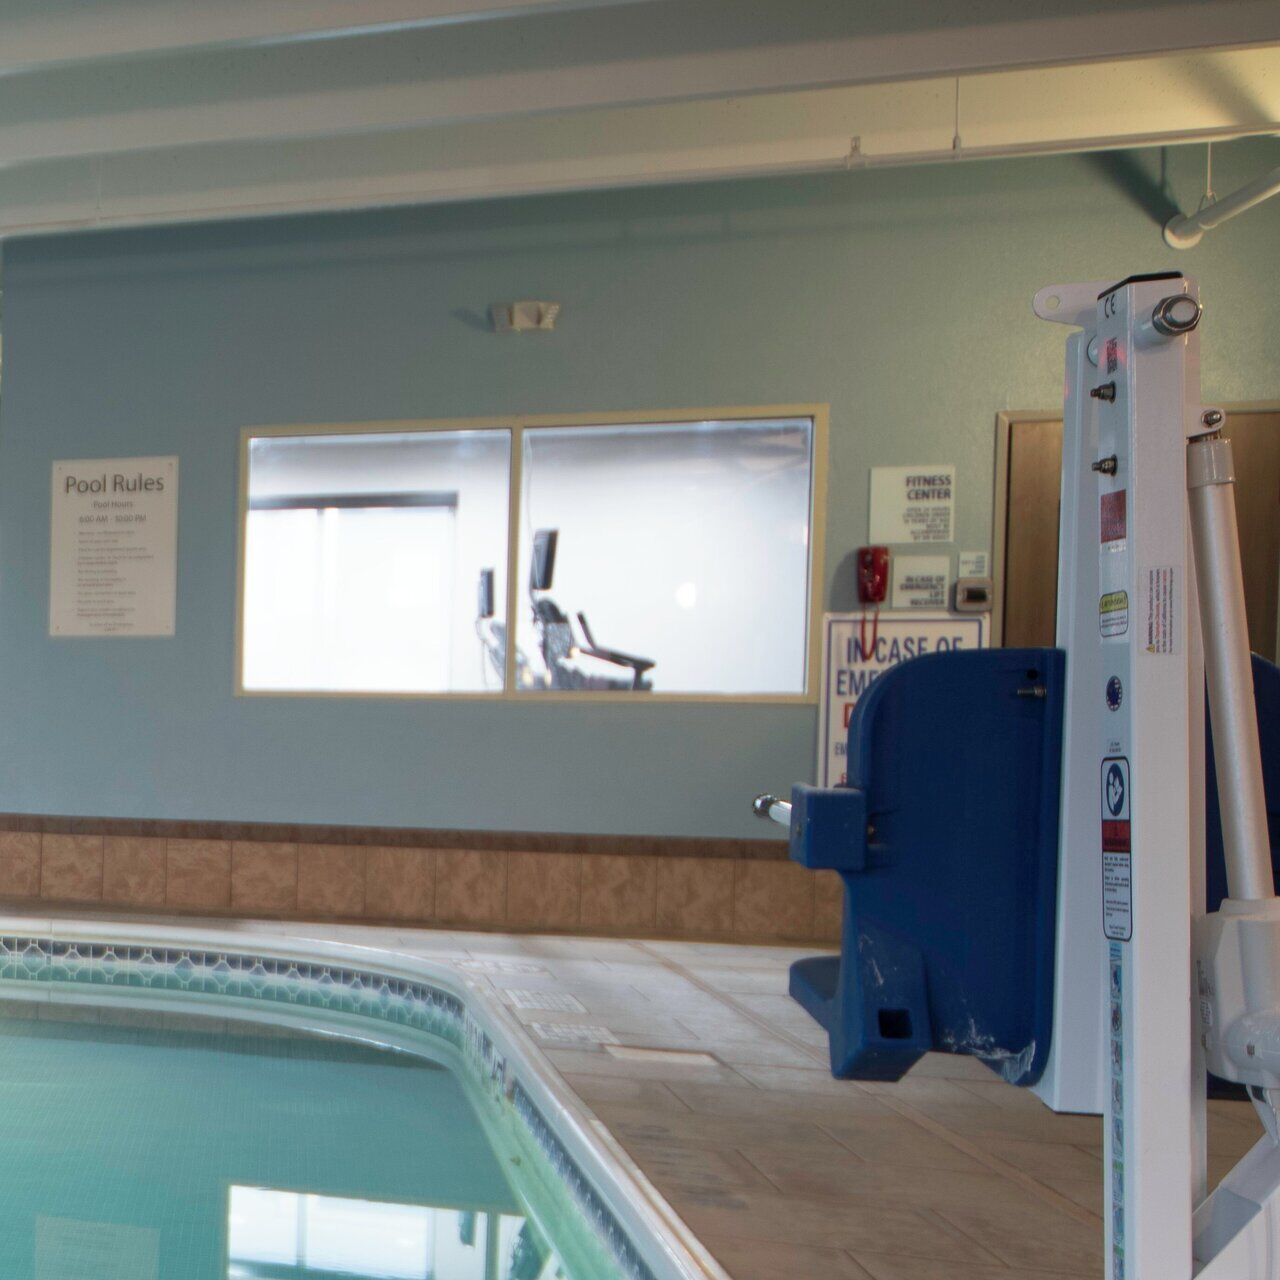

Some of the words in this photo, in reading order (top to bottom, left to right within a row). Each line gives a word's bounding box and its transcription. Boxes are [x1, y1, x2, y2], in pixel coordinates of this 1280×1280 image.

[65, 474, 106, 494] Pool
[113, 473, 164, 492] Rules
[906, 475, 951, 487] FITNESS
[907, 488, 951, 500] CENTER
[847, 637, 865, 663] IN
[875, 636, 928, 663] CASE
